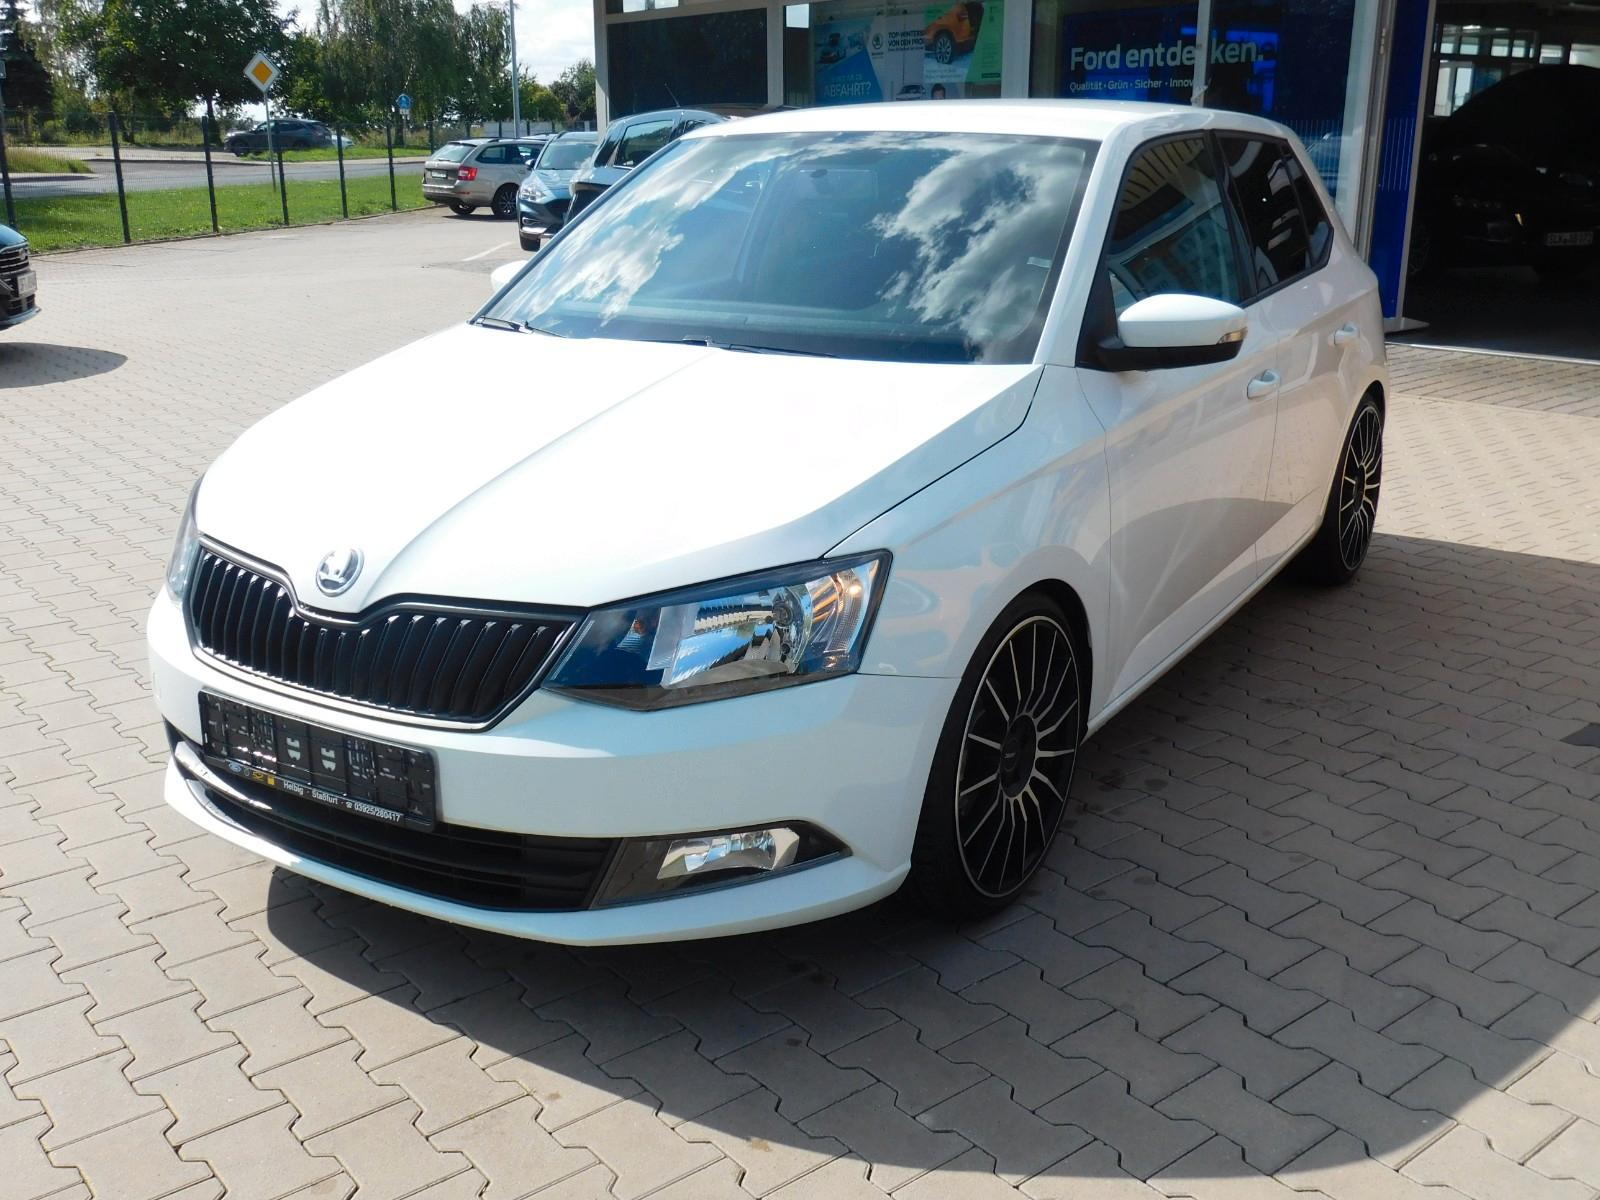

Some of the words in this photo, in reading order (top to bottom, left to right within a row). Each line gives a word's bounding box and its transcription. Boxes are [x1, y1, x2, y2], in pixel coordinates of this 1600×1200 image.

[1070, 44, 1120, 71] Ford
[1125, 38, 1263, 67] entdeken.
[824, 81, 871, 97] ABFAHRT?
[1069, 80, 1102, 92] Qualität
[1107, 79, 1128, 90] Grün
[1135, 78, 1162, 89] Sicher
[283, 780, 304, 796] Helbig
